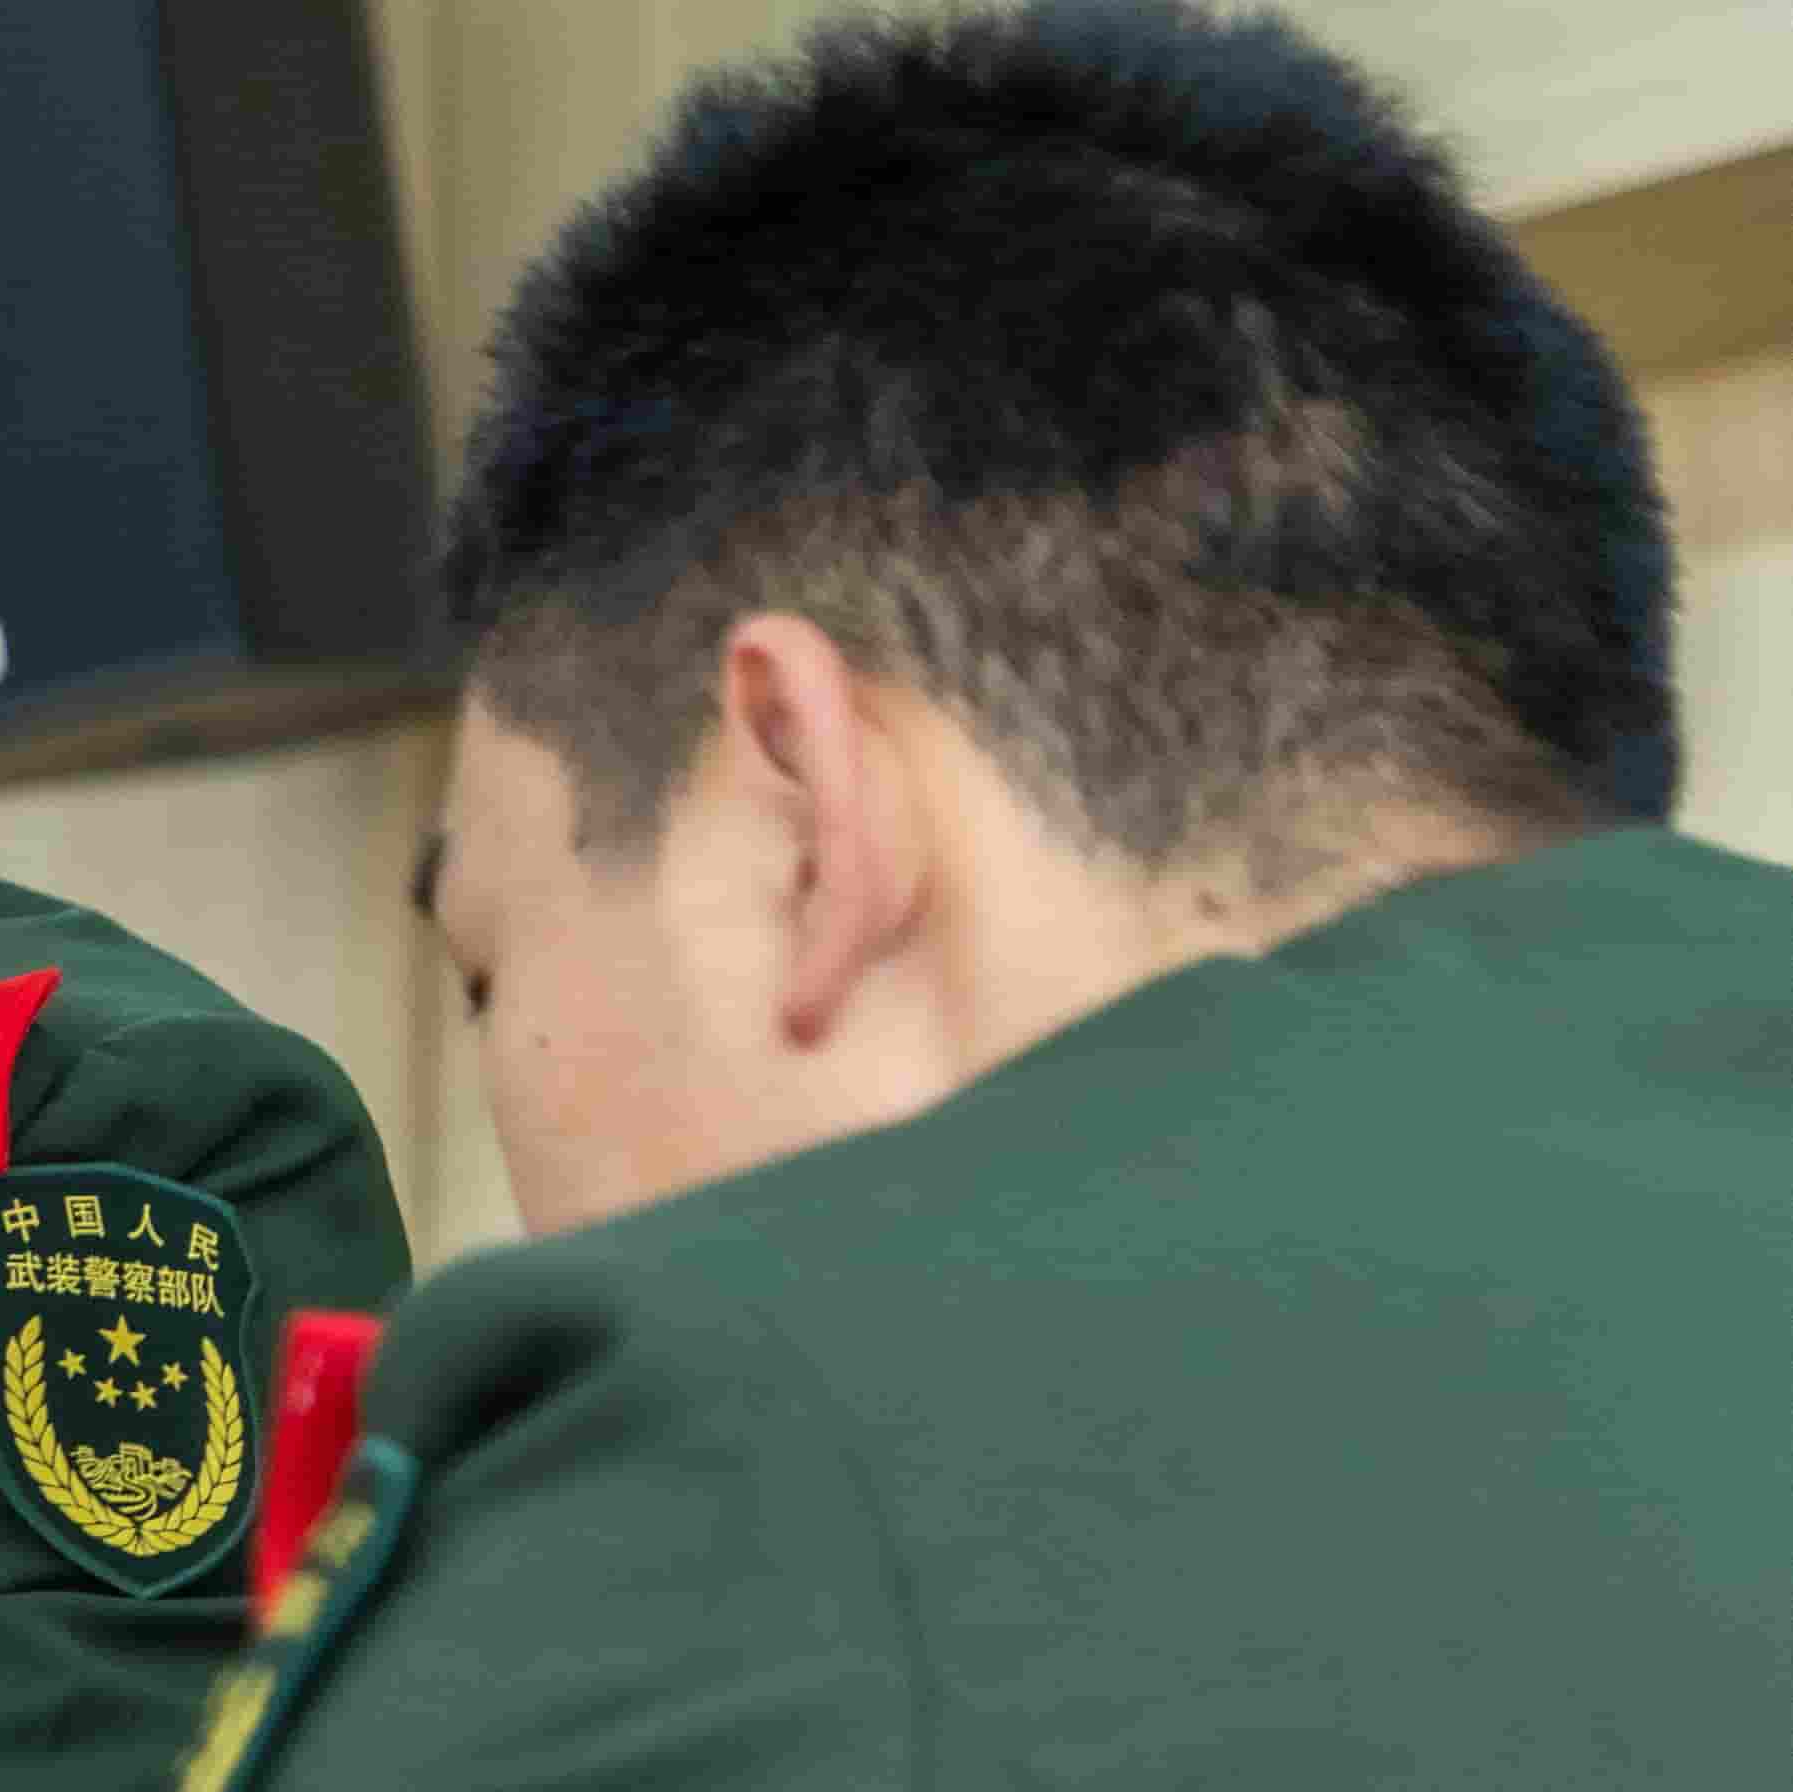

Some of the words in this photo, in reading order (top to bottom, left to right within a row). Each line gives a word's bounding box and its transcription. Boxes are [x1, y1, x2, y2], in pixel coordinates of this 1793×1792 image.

[0, 1195, 221, 1272] 中国人民
[5, 1251, 225, 1319] 武装警察部队
